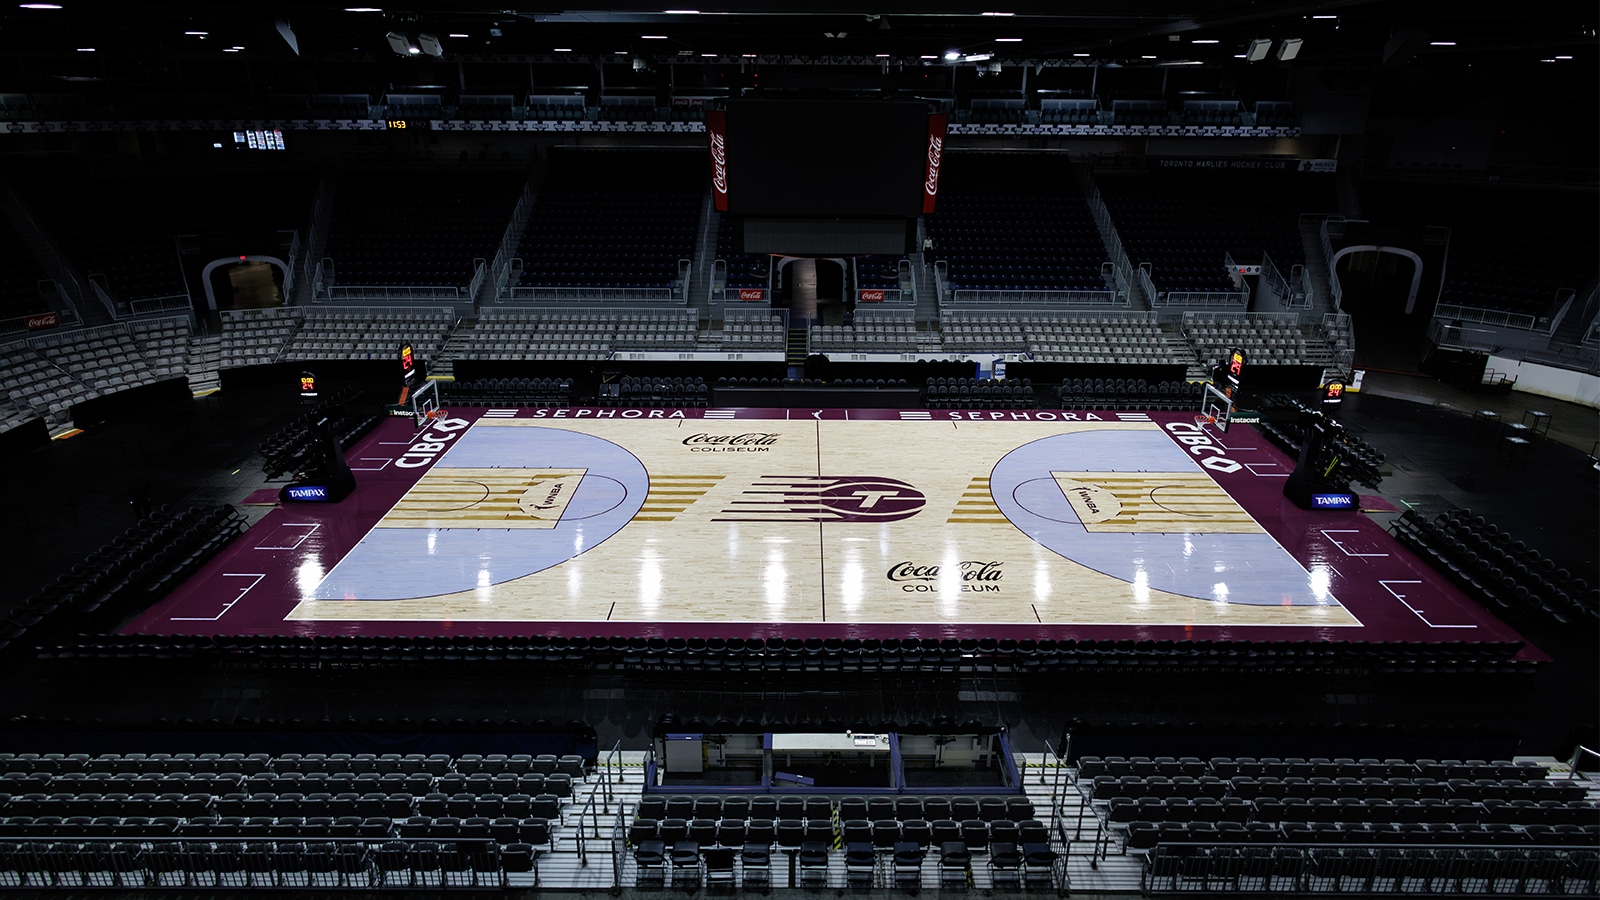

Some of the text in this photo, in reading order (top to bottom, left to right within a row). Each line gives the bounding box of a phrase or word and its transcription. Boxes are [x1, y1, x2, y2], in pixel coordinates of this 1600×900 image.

[710, 130, 727, 194] Coca-Cola
[925, 133, 942, 195] Coca-Cola
[1160, 160, 1286, 169] TORONTO MARLIES HOCKEY CLUB
[1328, 389, 1340, 397] 24
[532, 409, 686, 418] SEPHORA
[948, 411, 1103, 421] SEPHORA
[1165, 422, 1225, 455] CIBC
[395, 432, 456, 468] CIBC
[289, 489, 325, 498] TAMPAX
[543, 483, 564, 505] WNBA
[1315, 496, 1351, 505] TAMPAX
[1079, 491, 1100, 514] WNBA
